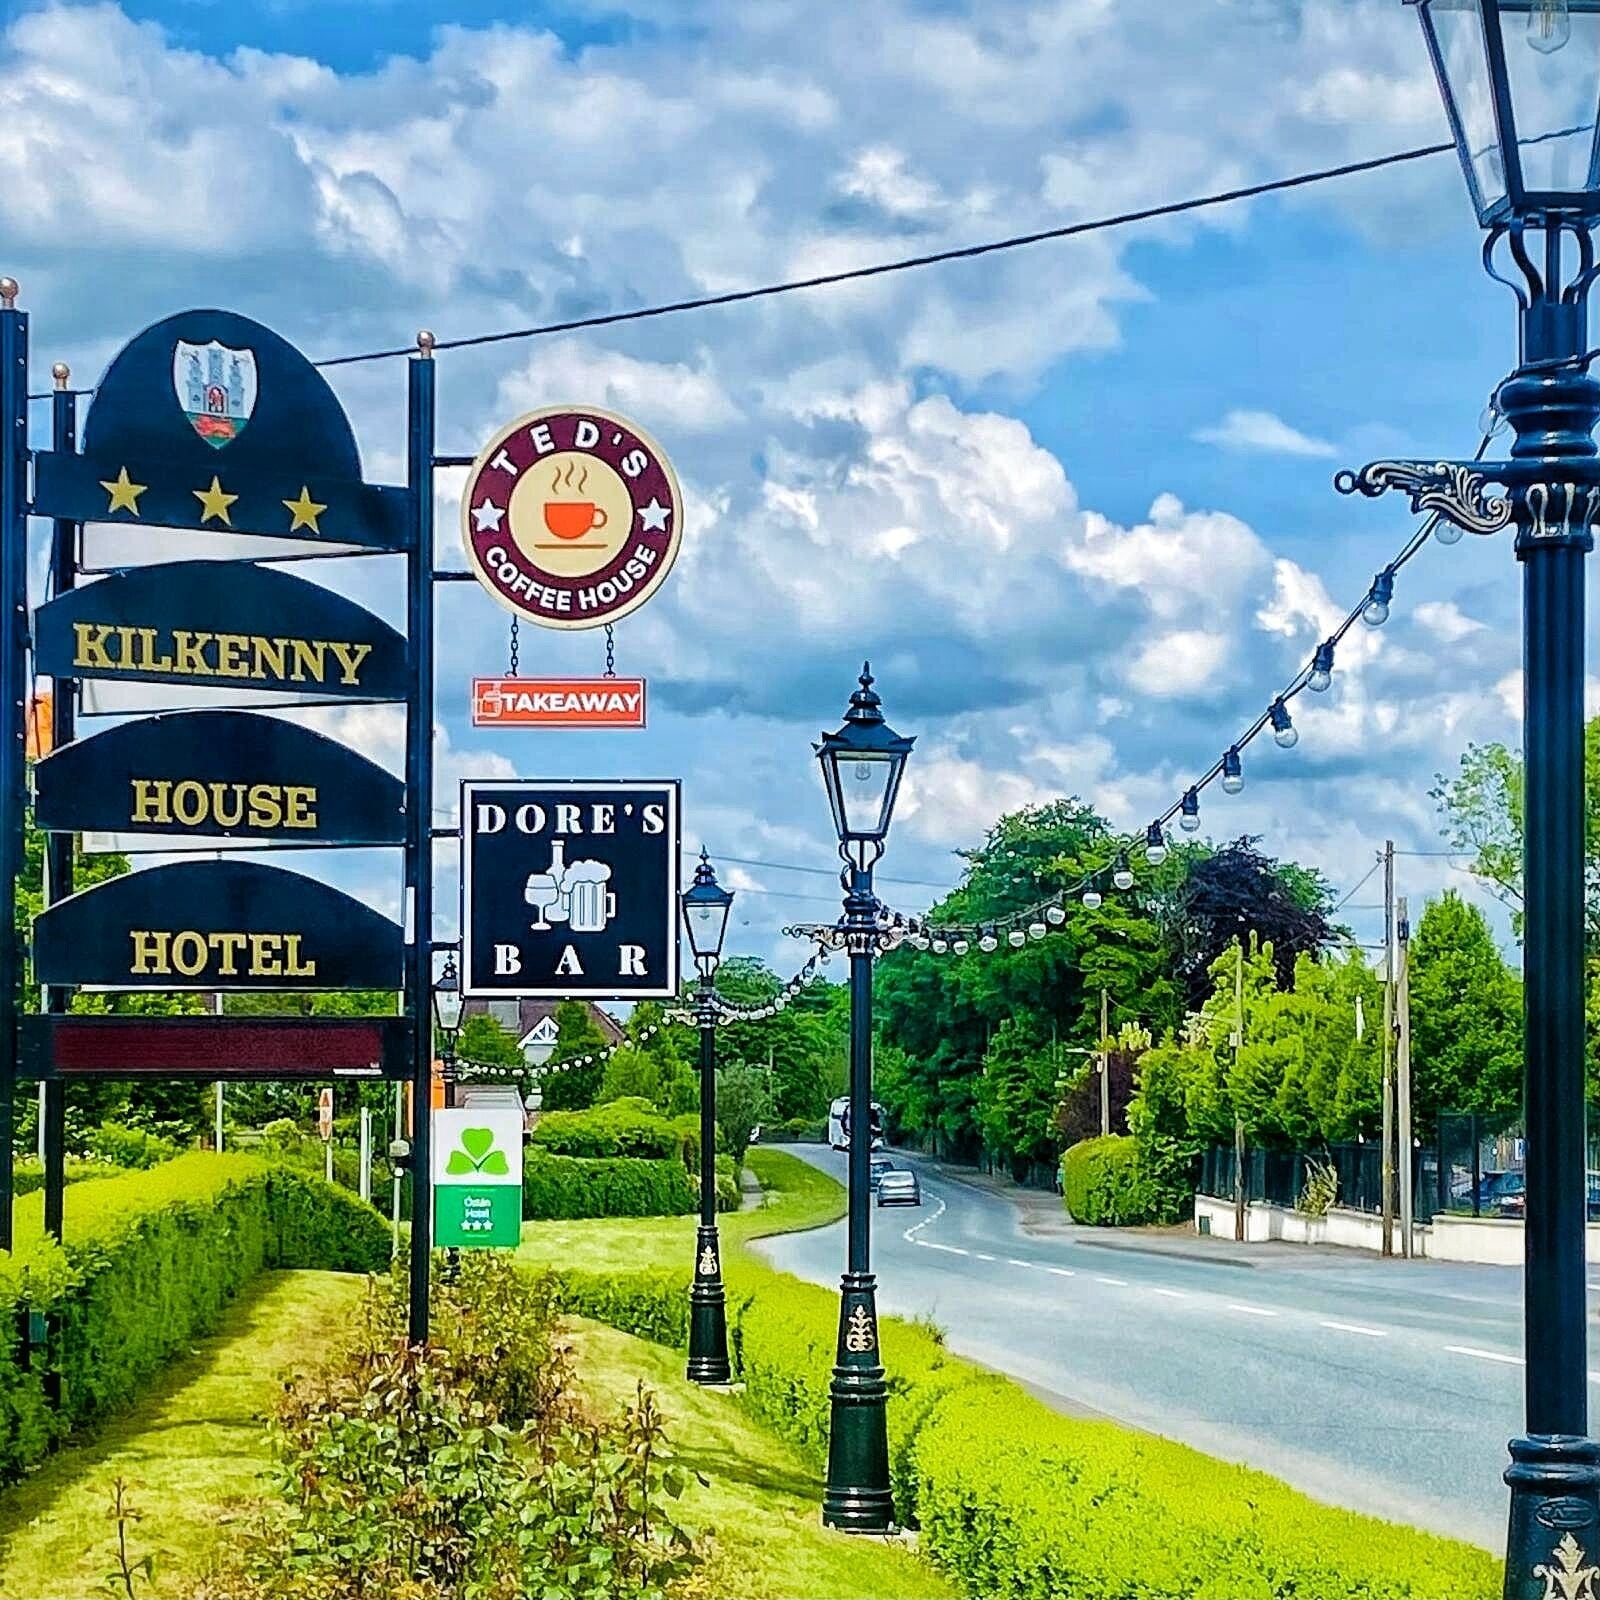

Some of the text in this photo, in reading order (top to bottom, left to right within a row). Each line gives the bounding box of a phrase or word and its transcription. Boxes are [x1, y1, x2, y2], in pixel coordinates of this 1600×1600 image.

[490, 420, 649, 478] TED'S
[486, 543, 657, 611] COFFEE HOUSE
[73, 623, 372, 685] KILKENNY
[502, 692, 641, 713] TAKEAWAY
[131, 779, 318, 829] HOUSE
[476, 803, 665, 835] DORE'S
[130, 931, 316, 977] HOTEL
[493, 944, 648, 976] BAR
